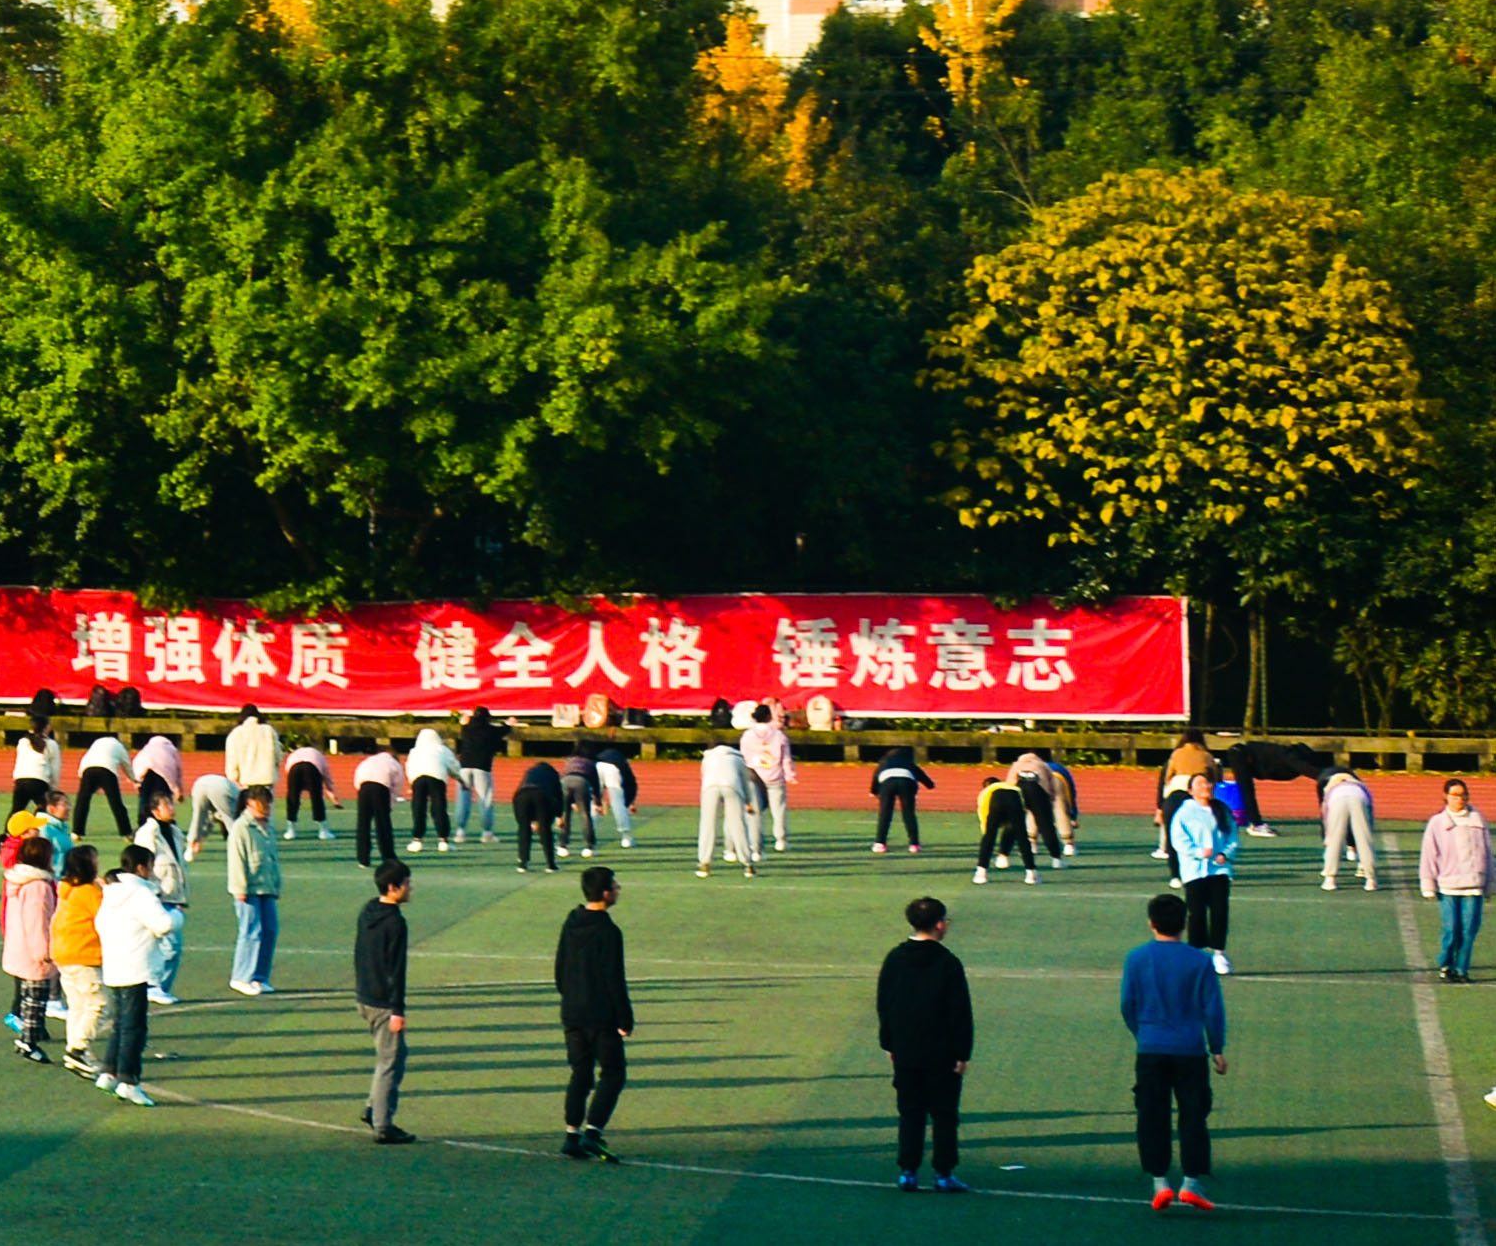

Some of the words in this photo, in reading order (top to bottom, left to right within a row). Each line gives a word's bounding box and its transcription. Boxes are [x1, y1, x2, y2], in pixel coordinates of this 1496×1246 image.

[71, 612, 350, 688] 增强体质
[413, 618, 707, 690] 健全人格
[772, 618, 1075, 690] 锤炼意志
